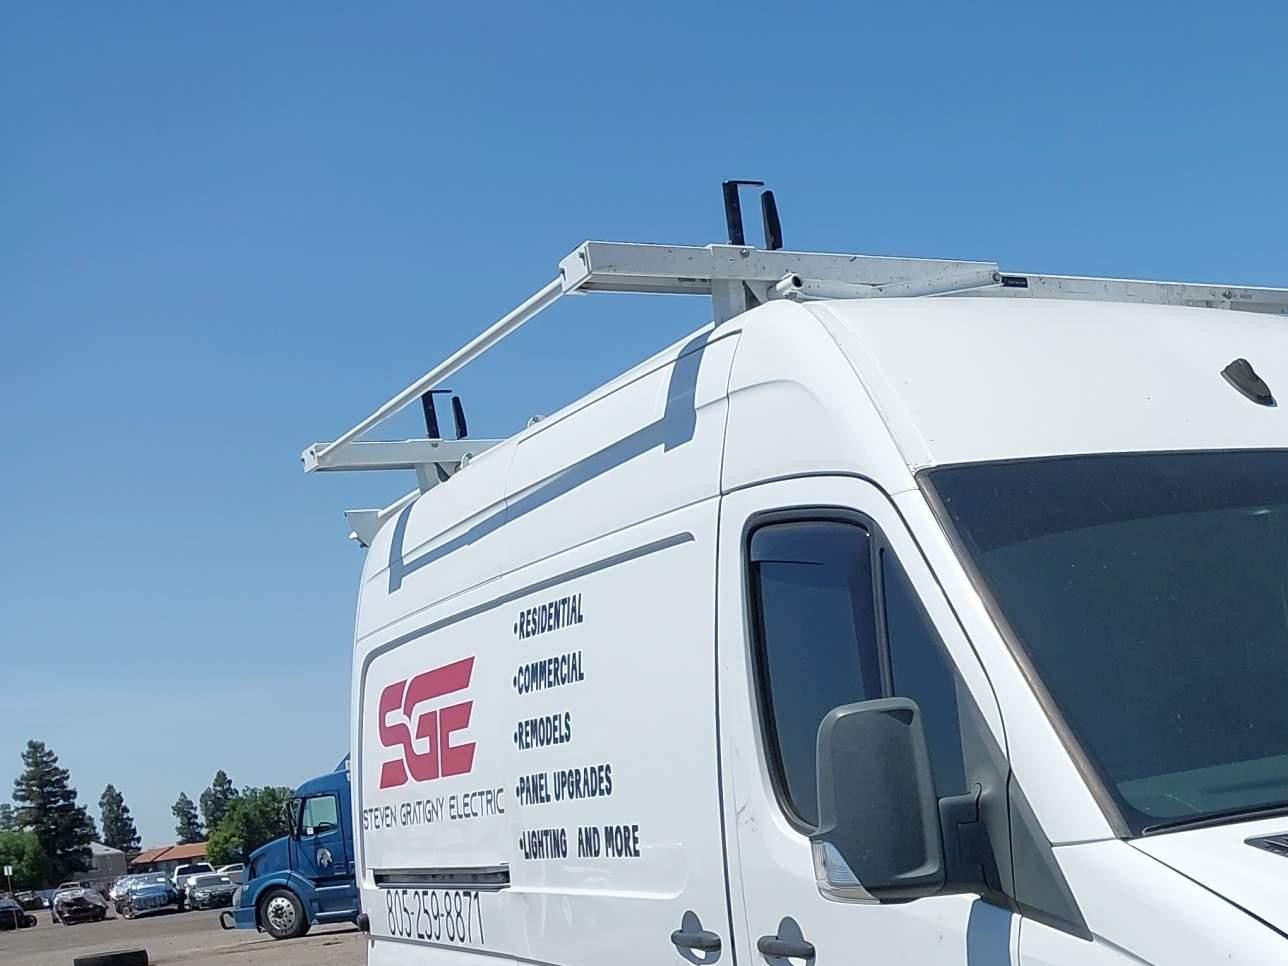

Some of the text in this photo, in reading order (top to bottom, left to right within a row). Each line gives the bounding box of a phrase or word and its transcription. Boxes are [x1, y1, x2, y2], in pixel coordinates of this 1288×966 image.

[519, 593, 583, 640] RESIDENTIAL
[517, 650, 584, 695] COMMERCIAL
[379, 656, 476, 790] SGE
[518, 711, 571, 750] REMODELS
[519, 764, 612, 806] PANEL UPGRADES
[363, 788, 505, 830] STEVEN GRATIGNY ELECTRIC
[522, 825, 640, 860] LIGHTING AND MORE
[386, 889, 485, 945] 805-259-8871
